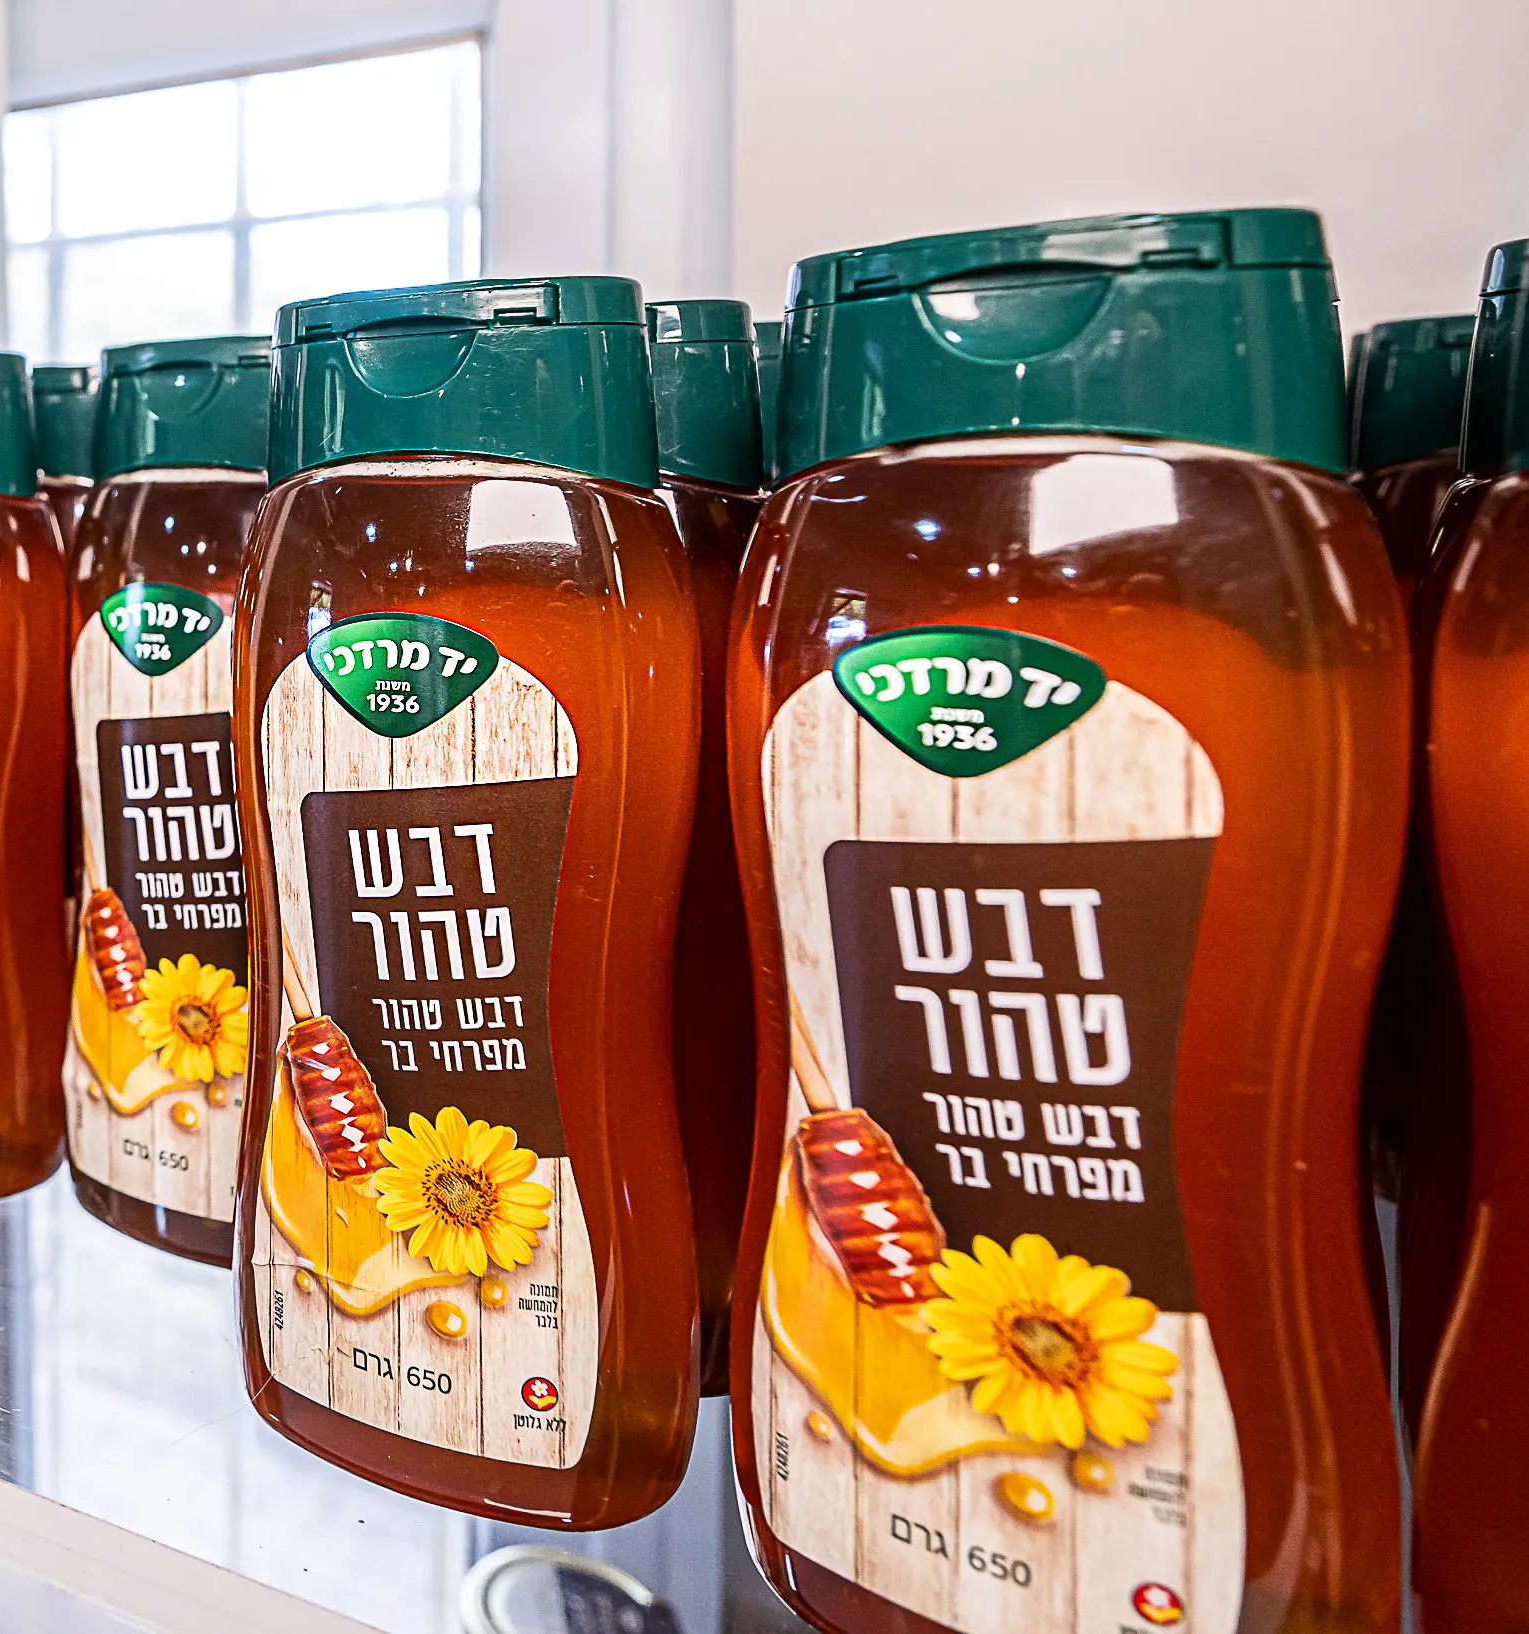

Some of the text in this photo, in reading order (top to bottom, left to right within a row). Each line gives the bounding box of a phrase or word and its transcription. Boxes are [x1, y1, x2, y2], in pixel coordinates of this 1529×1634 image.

[108, 601, 210, 634] יד מרדכי
[323, 639, 478, 677] יד מרדכי
[375, 679, 411, 692] משנת
[855, 656, 1082, 709] יד מרדכי
[366, 693, 420, 714] 1936
[916, 722, 998, 751] 1936
[121, 740, 222, 800] דבש
[122, 804, 235, 862] טהור
[348, 823, 497, 898] דבש
[134, 871, 241, 898] דבש טהור
[141, 903, 242, 930] מפרחי בר
[890, 886, 1104, 980] דבש
[351, 906, 516, 981] טהור
[371, 995, 524, 1030] דבש טהור
[894, 984, 1131, 1086] טהור
[381, 1038, 527, 1072] מפרחי בר
[922, 1091, 1142, 1150] דבש טהור
[935, 1143, 1145, 1203] מפרחי בר
[518, 1297, 558, 1314] להמחשה
[530, 1283, 559, 1298] תמונה
[274, 1290, 284, 1331] 4248261
[352, 1347, 452, 1395] 650 גרם
[513, 1414, 542, 1430] גלוטן
[890, 1513, 1032, 1589] 650 גרם
